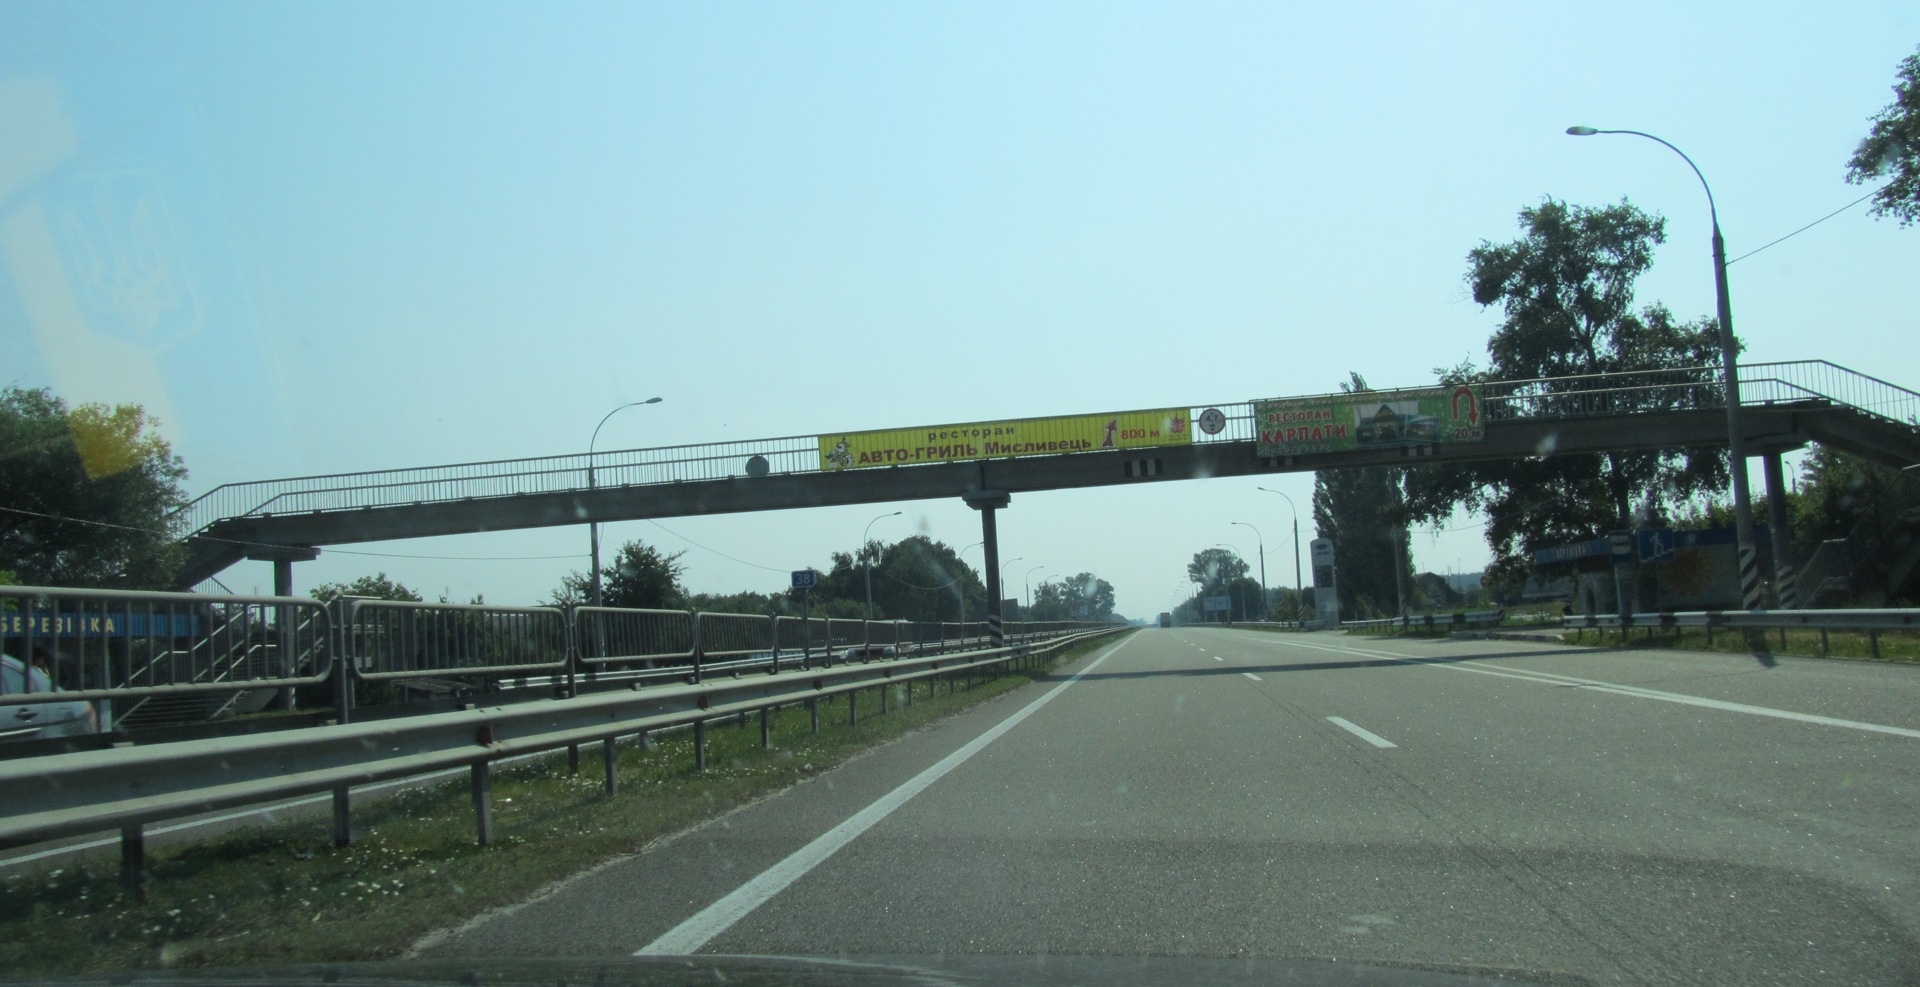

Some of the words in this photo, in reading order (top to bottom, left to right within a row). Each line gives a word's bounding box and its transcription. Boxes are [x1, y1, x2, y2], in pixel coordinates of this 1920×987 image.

[1267, 409, 1332, 424] РЕСТОРАН
[928, 427, 1015, 442] ресторан
[1121, 428, 1146, 440] 800
[1150, 430, 1160, 438] м
[1261, 423, 1348, 445] КАРПАТИ
[1453, 427, 1469, 440] 20
[859, 443, 978, 464] АВТО-ГРИЛЬ
[985, 439, 1092, 455] Мисливець
[795, 573, 811, 585] 38
